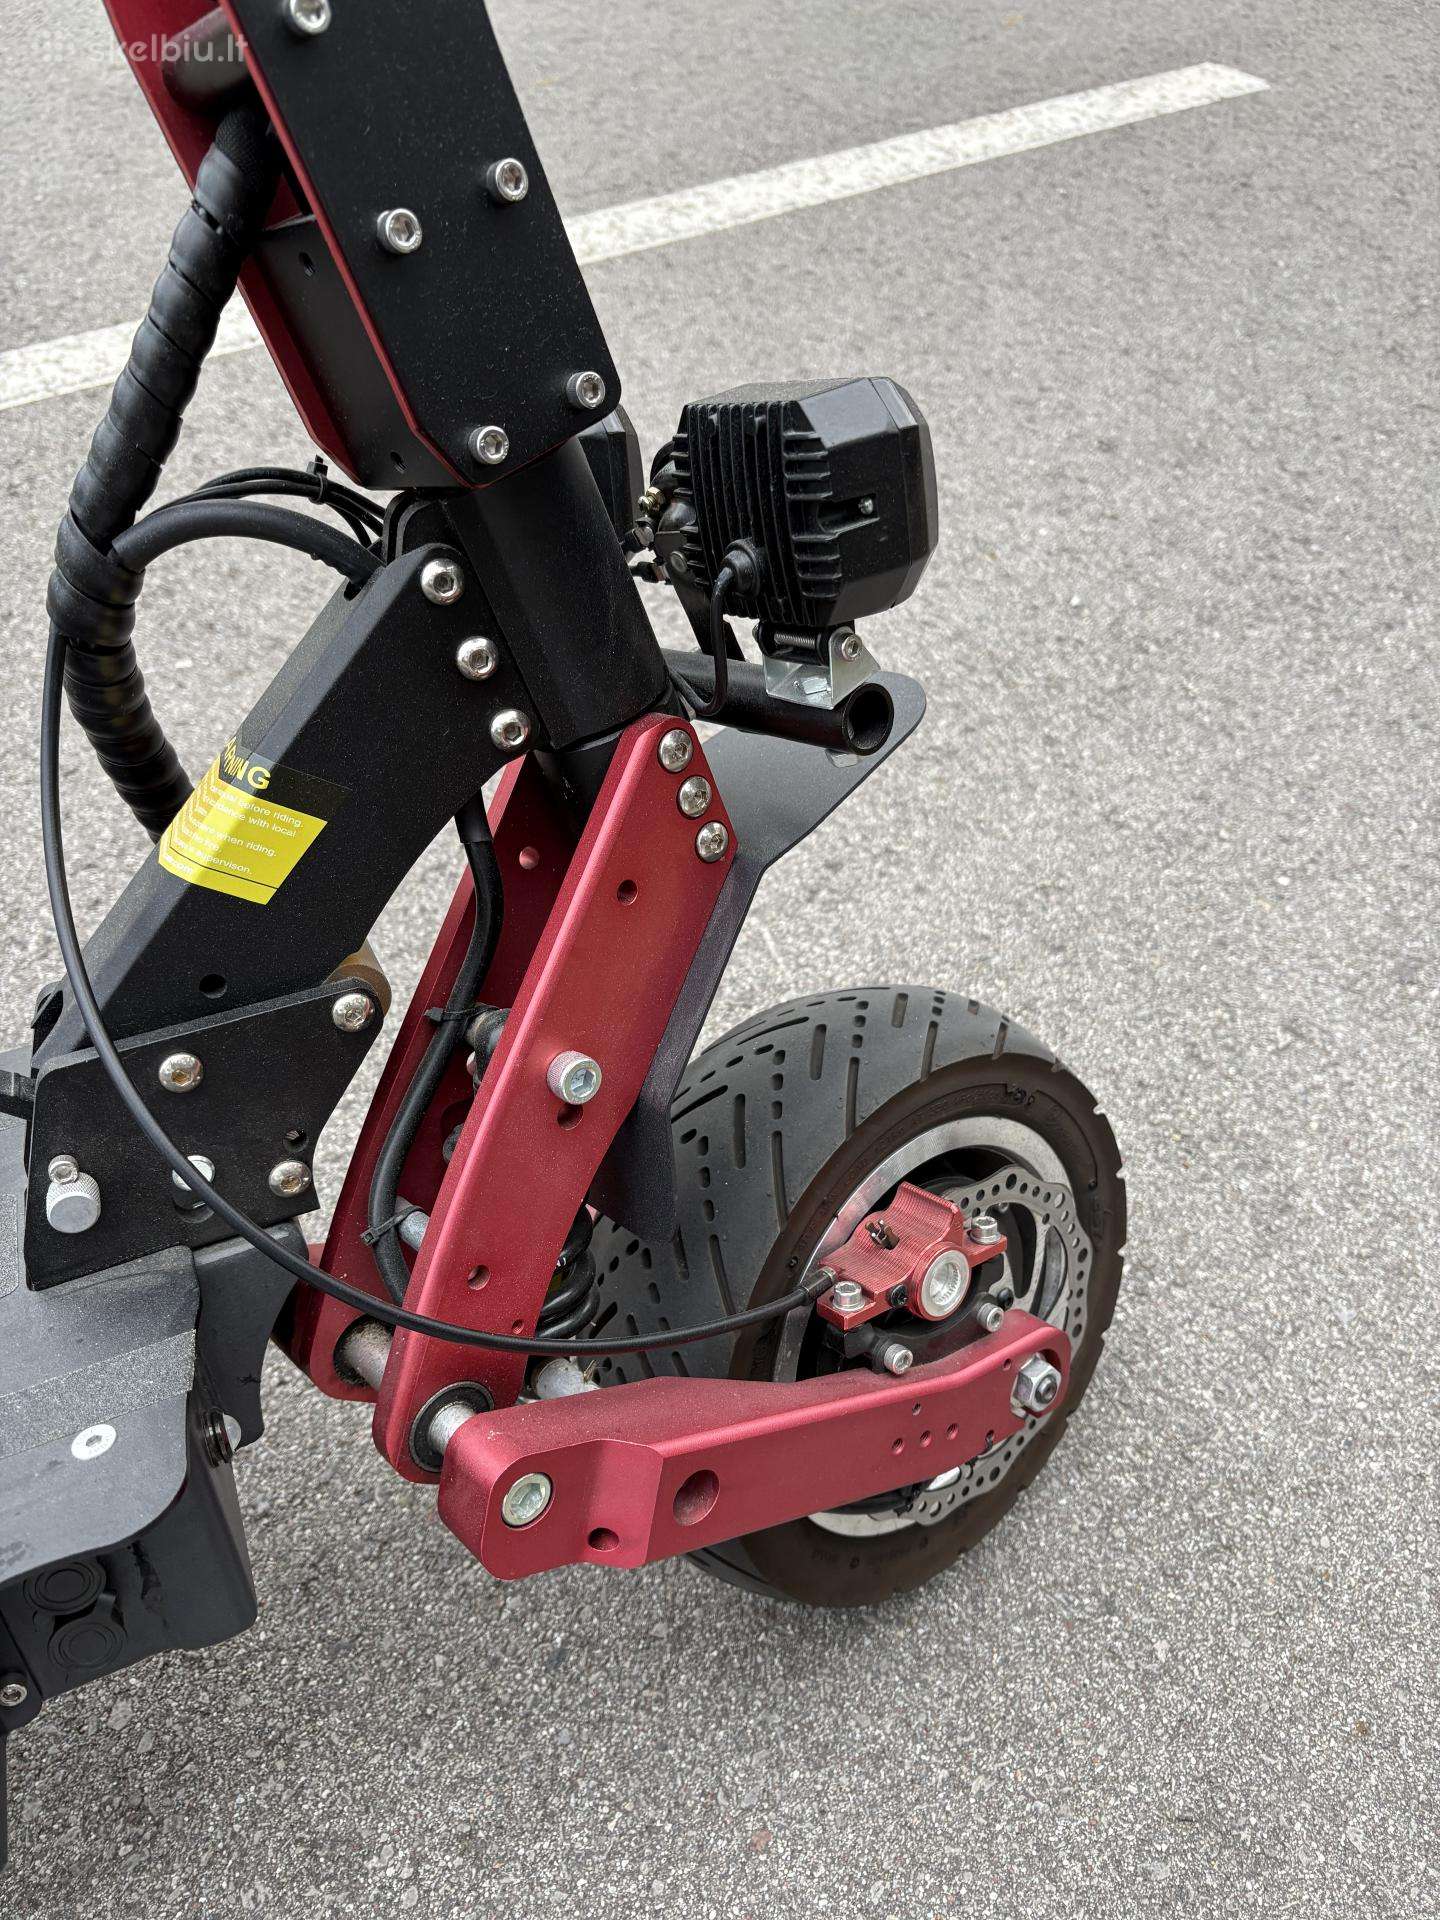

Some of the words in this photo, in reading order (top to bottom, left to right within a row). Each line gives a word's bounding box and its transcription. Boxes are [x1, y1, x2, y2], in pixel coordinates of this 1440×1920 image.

[248, 817, 269, 829] with
[271, 823, 297, 838] local
[273, 811, 304, 828] riding.
[246, 841, 276, 857] riding.
